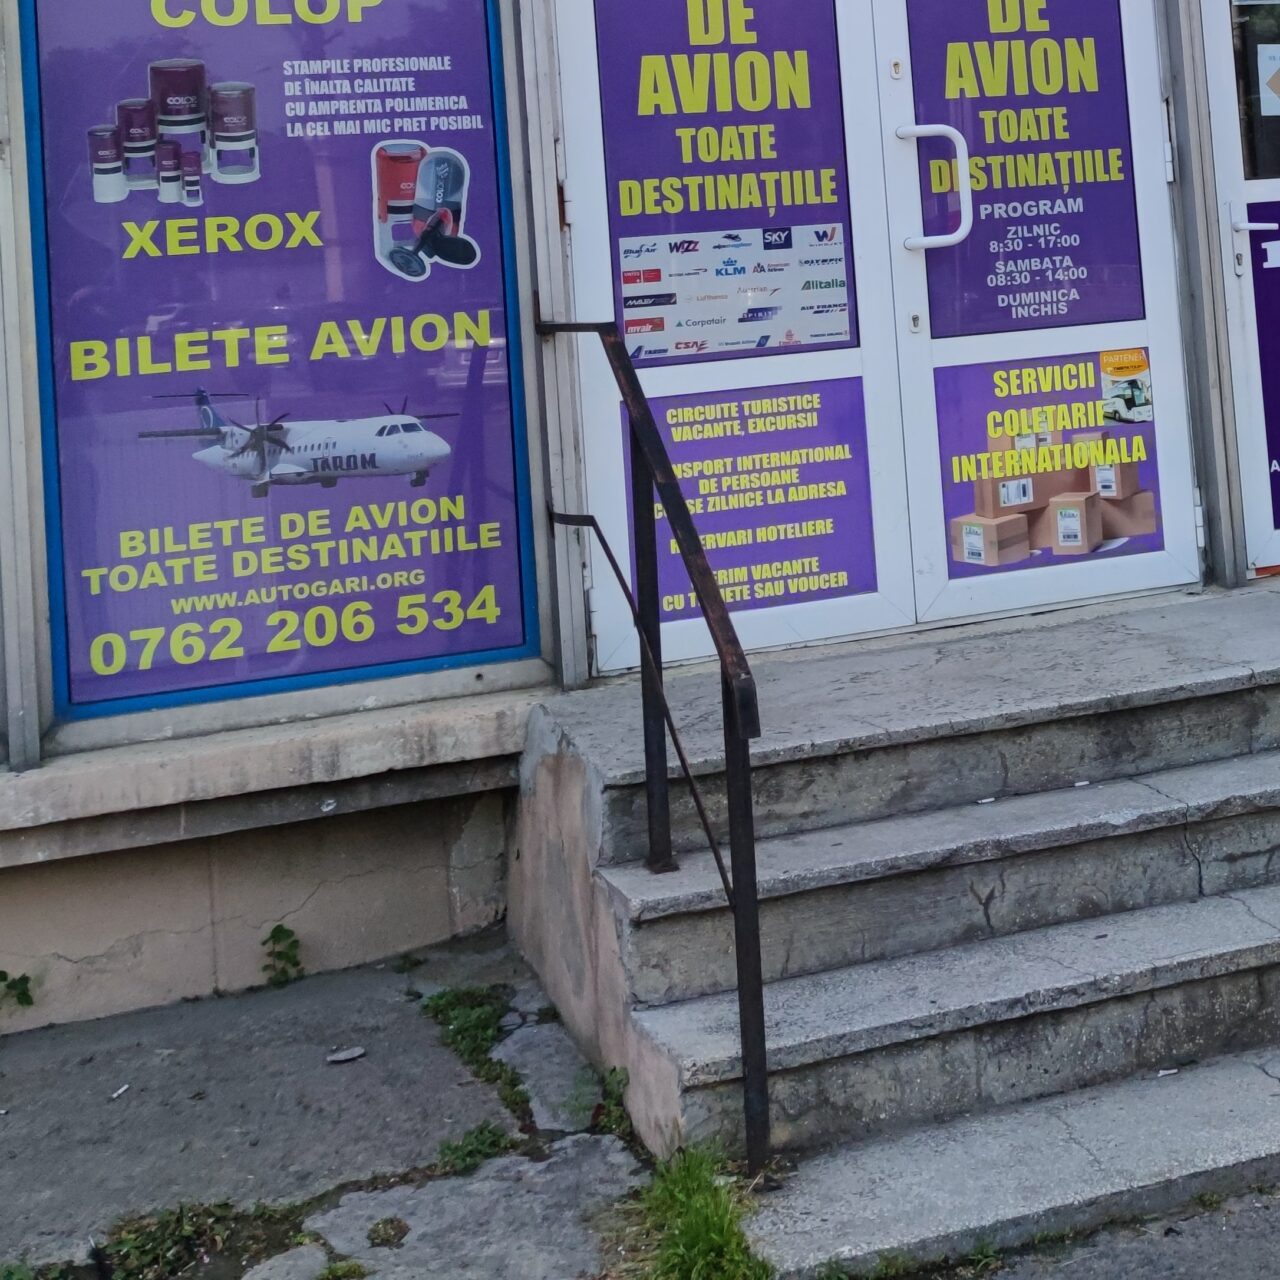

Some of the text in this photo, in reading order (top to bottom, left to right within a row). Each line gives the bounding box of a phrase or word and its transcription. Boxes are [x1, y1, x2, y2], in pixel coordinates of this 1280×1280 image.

[283, 56, 451, 75] STAMPILE PROFESIONALE
[945, 38, 1098, 99] AVION
[284, 78, 415, 96] DE ÎNALTA CALITATE
[638, 50, 811, 116] AVION
[285, 96, 468, 116] CU AMPRENTA POLIMERICA
[287, 115, 483, 137] LA CEL MAI MIC PRET POSIBIL
[979, 107, 1069, 143] TOATE
[676, 124, 777, 163] TOATE
[619, 169, 837, 217] DESTINAȚIILE
[980, 198, 1084, 220] PROGRAM
[121, 211, 324, 259] XEROX
[989, 234, 1080, 253] 8:30 17:00
[1007, 223, 1061, 239] ZILNIC
[715, 266, 746, 276] KLM
[987, 266, 1088, 287] 08:30 14:00
[995, 255, 1074, 274] SAMBATA
[801, 278, 846, 291] Alitalia
[998, 288, 1080, 307] DUMINICA
[1011, 302, 1068, 319] INCHIS
[70, 310, 491, 381] BILETE AVION
[993, 362, 1096, 397] SERVICII
[666, 393, 821, 425] CIRCUITE TURISTICE
[671, 412, 818, 442] VACANTE, EXCURSII
[737, 444, 852, 471] INTERNATIONAL
[952, 436, 1147, 483] INTERNATIONALA
[699, 469, 799, 495] DE PERSOANE
[707, 481, 846, 512] ZILNICE LA ADRESA
[119, 495, 465, 558] BILETE DE AVION
[756, 519, 834, 545] HOTELIERE
[82, 522, 502, 595] TOATE DESTINATIILE
[751, 557, 819, 581] VACANTE
[172, 569, 426, 615] WWW.AUTOGARI.ORG
[663, 572, 848, 612] CU SAU VOUCER
[90, 585, 501, 676] 0762 206 534
